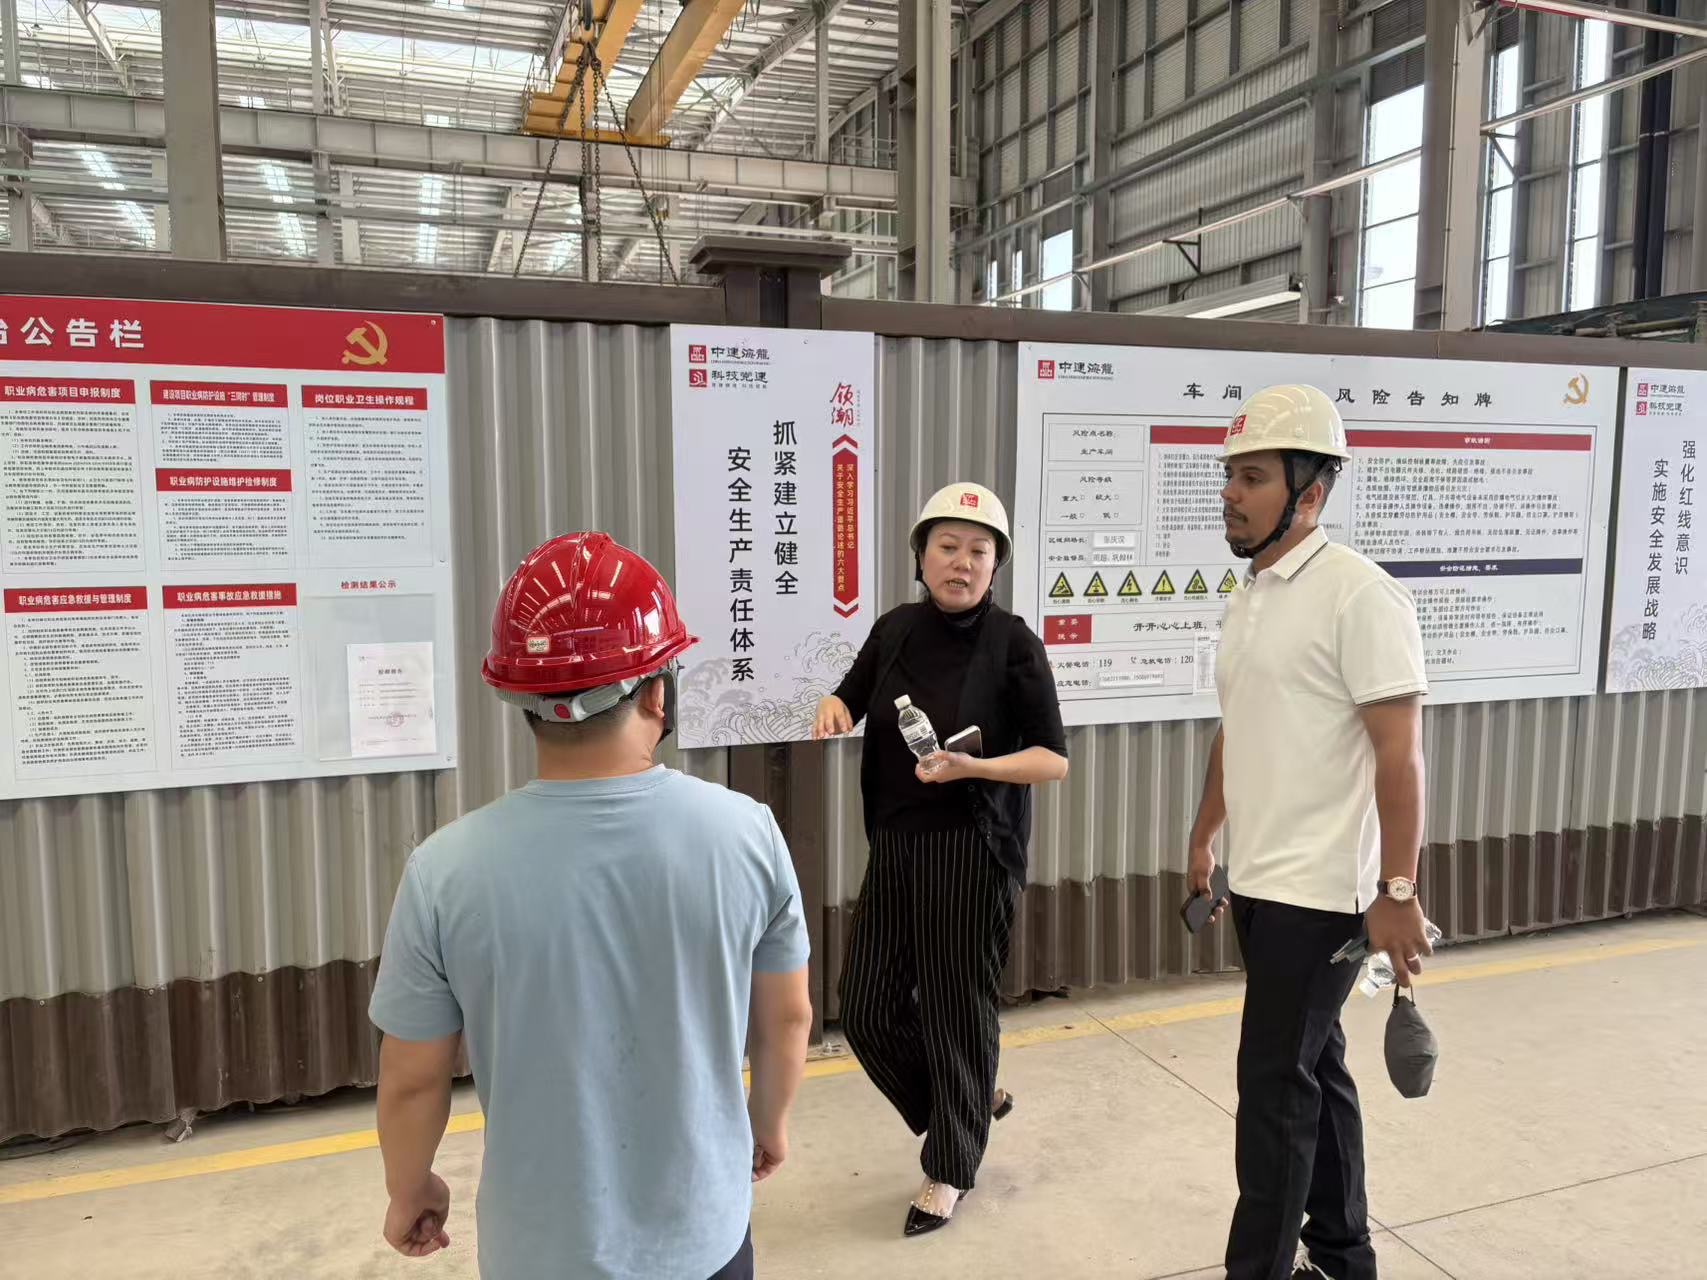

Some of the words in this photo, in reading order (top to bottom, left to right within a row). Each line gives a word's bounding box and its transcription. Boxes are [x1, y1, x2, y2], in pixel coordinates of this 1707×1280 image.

[4, 385, 121, 399] 职业病危害项目申报制度
[314, 393, 415, 406] 岗位职业卫生操作规程
[1183, 383, 1243, 400] 车间
[1335, 388, 1492, 407] 风险告知牌
[169, 475, 277, 488] 职业病防护设施维护检修制度
[773, 420, 799, 595] 抓紧建立健全
[846, 464, 855, 549] 深入学习习近平总书记
[1674, 440, 1696, 576] 强化红线意识
[1642, 458, 1669, 640] 实施安全发展战略
[728, 447, 755, 681] 安全生产责任体系
[340, 578, 397, 590] 检测结果公示
[18, 592, 132, 606] 职业病危害应急救援与管理制度
[176, 589, 282, 603] 职业病危害事故应急救援措施
